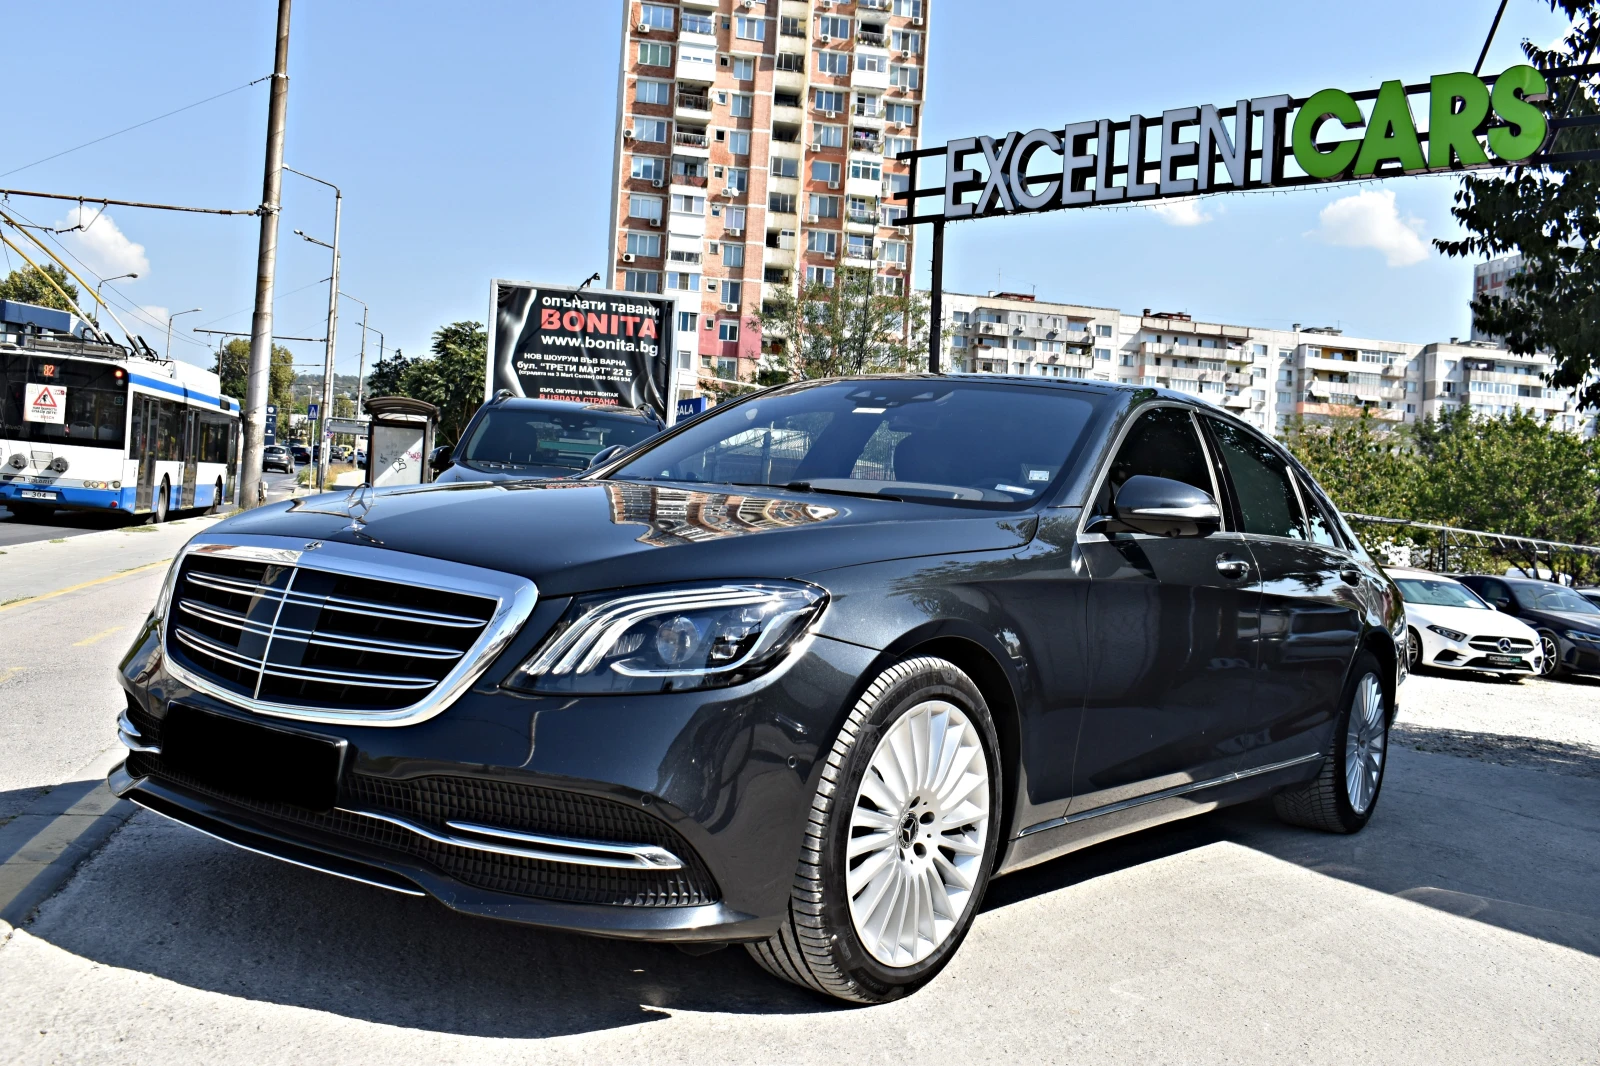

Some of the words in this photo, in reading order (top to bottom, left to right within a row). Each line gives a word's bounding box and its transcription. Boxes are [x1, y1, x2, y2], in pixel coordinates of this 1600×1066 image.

[944, 94, 1290, 218] EXCELLENT
[1291, 64, 1548, 179] CARS
[542, 296, 607, 311] опънати
[610, 302, 660, 316] тавани
[541, 308, 659, 339] BONITA
[541, 334, 659, 357] www.bonita.bg
[516, 360, 538, 370] бул.
[613, 368, 624, 376] 22
[625, 369, 633, 377] Б
[523, 352, 542, 360] НОВ
[543, 353, 579, 363] ШОУРУМ
[580, 356, 598, 364] ВЪВ
[600, 358, 627, 367] ВАРНА
[43, 364, 55, 377] 82
